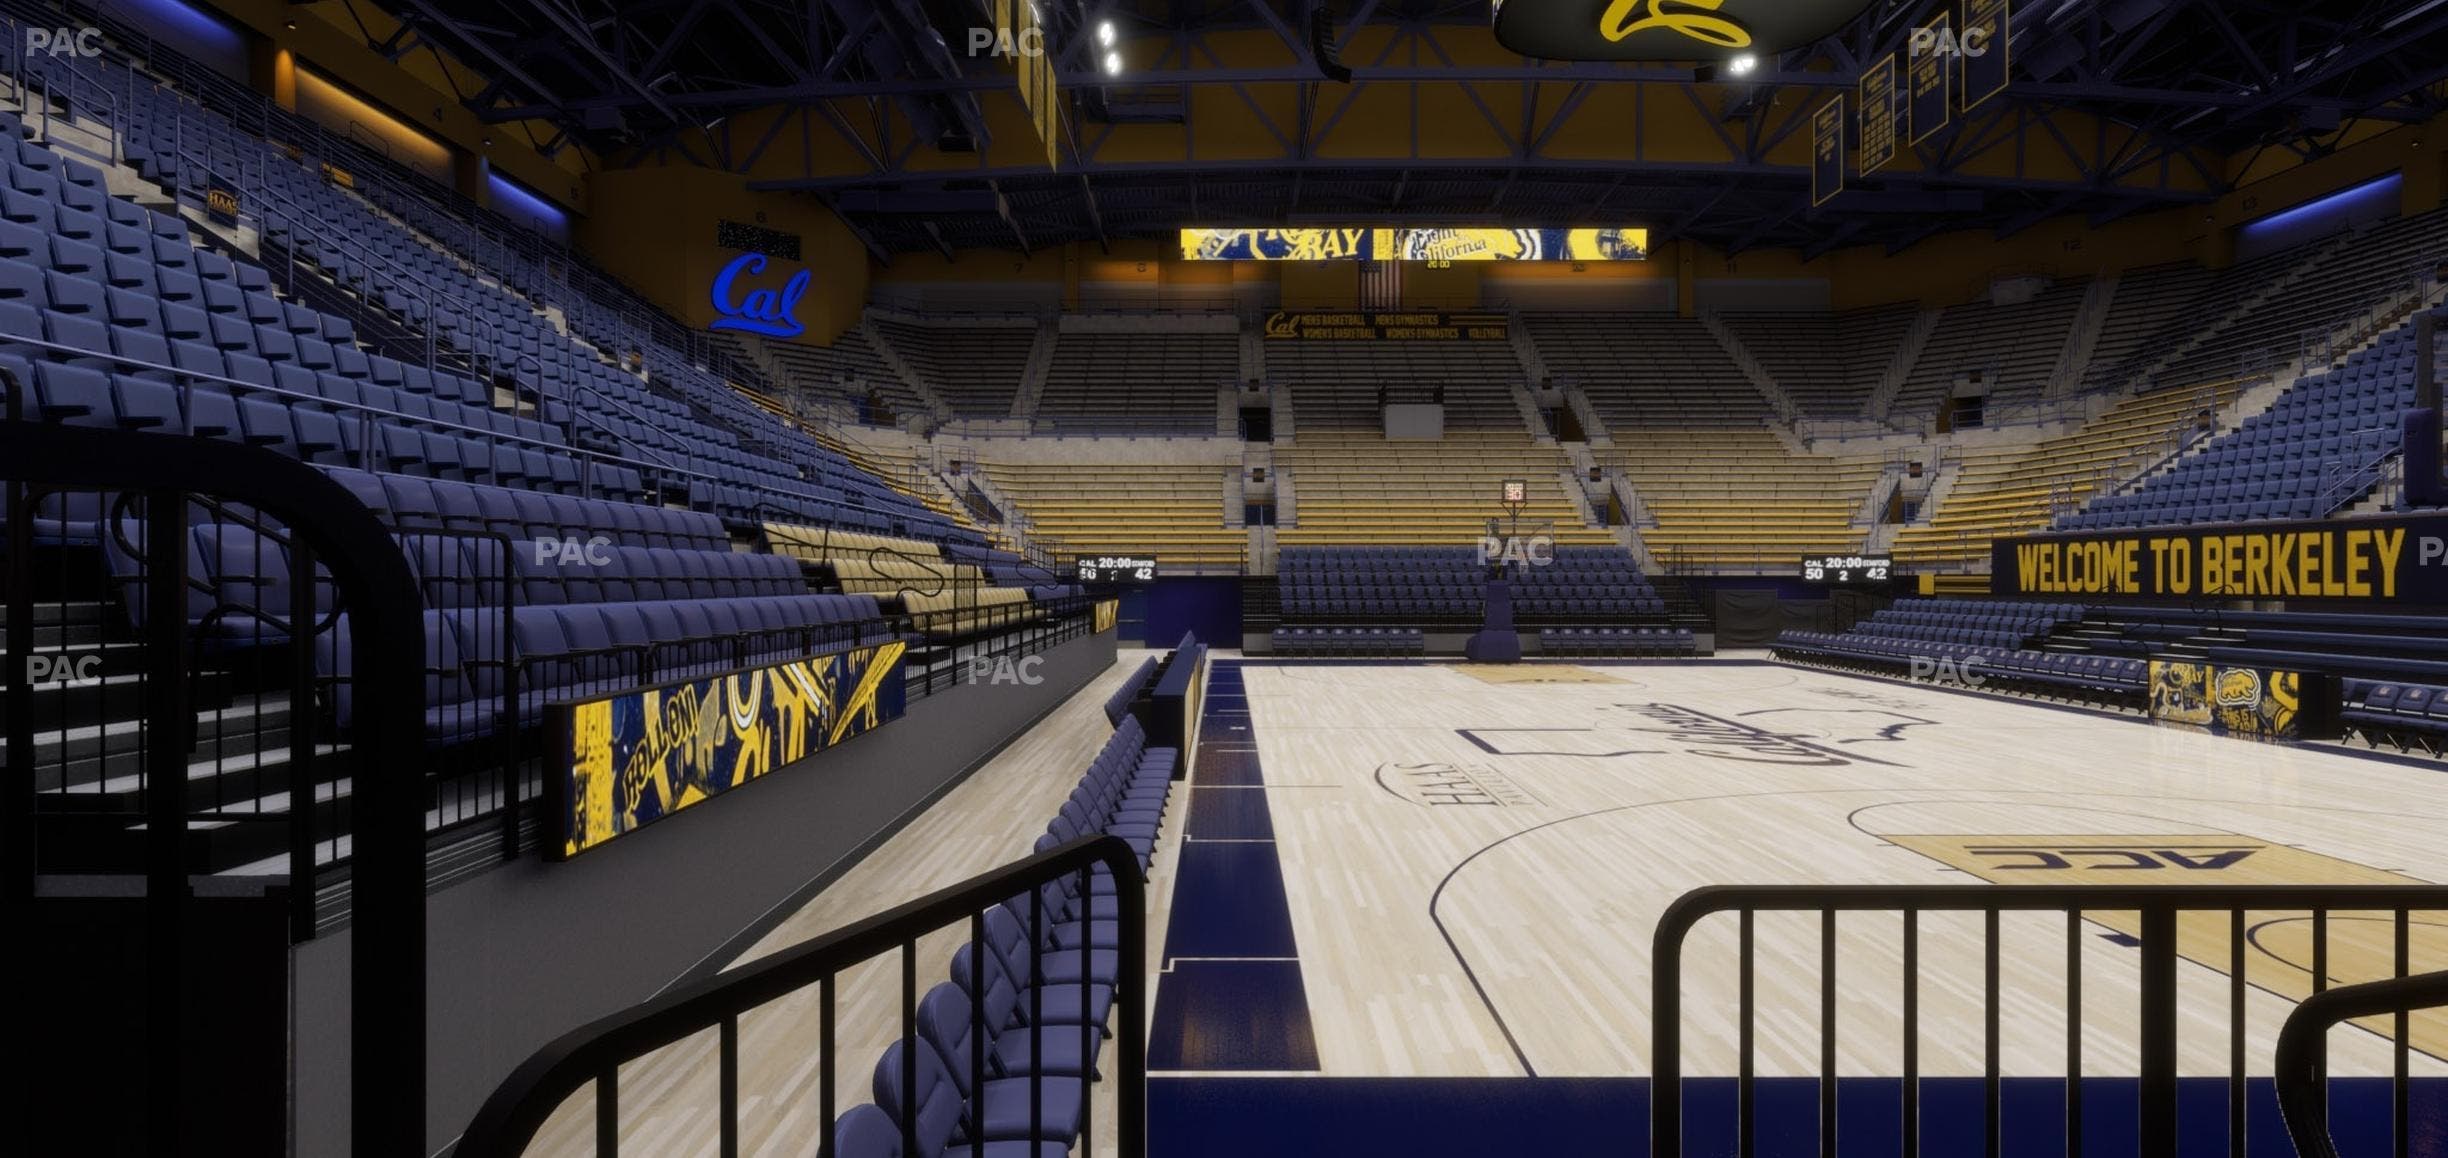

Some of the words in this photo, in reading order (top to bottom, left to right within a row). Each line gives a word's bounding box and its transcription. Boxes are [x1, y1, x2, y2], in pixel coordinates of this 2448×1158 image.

[708, 249, 812, 338] Cal
[1264, 311, 1301, 339] Cal
[1322, 314, 1366, 326] BASKETBALL
[1398, 314, 1439, 326] GYMNASTICS
[1333, 328, 1376, 339] BASKETBALL
[1417, 328, 1459, 339] GYMNASTICS
[1468, 328, 1506, 339] VOLLEYBALL
[1079, 559, 1097, 568] CAL
[1098, 557, 1131, 569] 20:00
[1804, 560, 1824, 568] CAL
[1825, 557, 1862, 568] 20:00
[2016, 539, 2140, 593] WELCOME
[2150, 537, 2192, 594] TO
[2202, 528, 2406, 597] BERKELEY
[1134, 568, 1153, 580] 42
[1805, 568, 1824, 580] 50
[1839, 570, 1849, 581] 2
[1866, 568, 1887, 580] 42
[1393, 762, 1500, 807] HAAS
[1968, 849, 2258, 870] ACC
